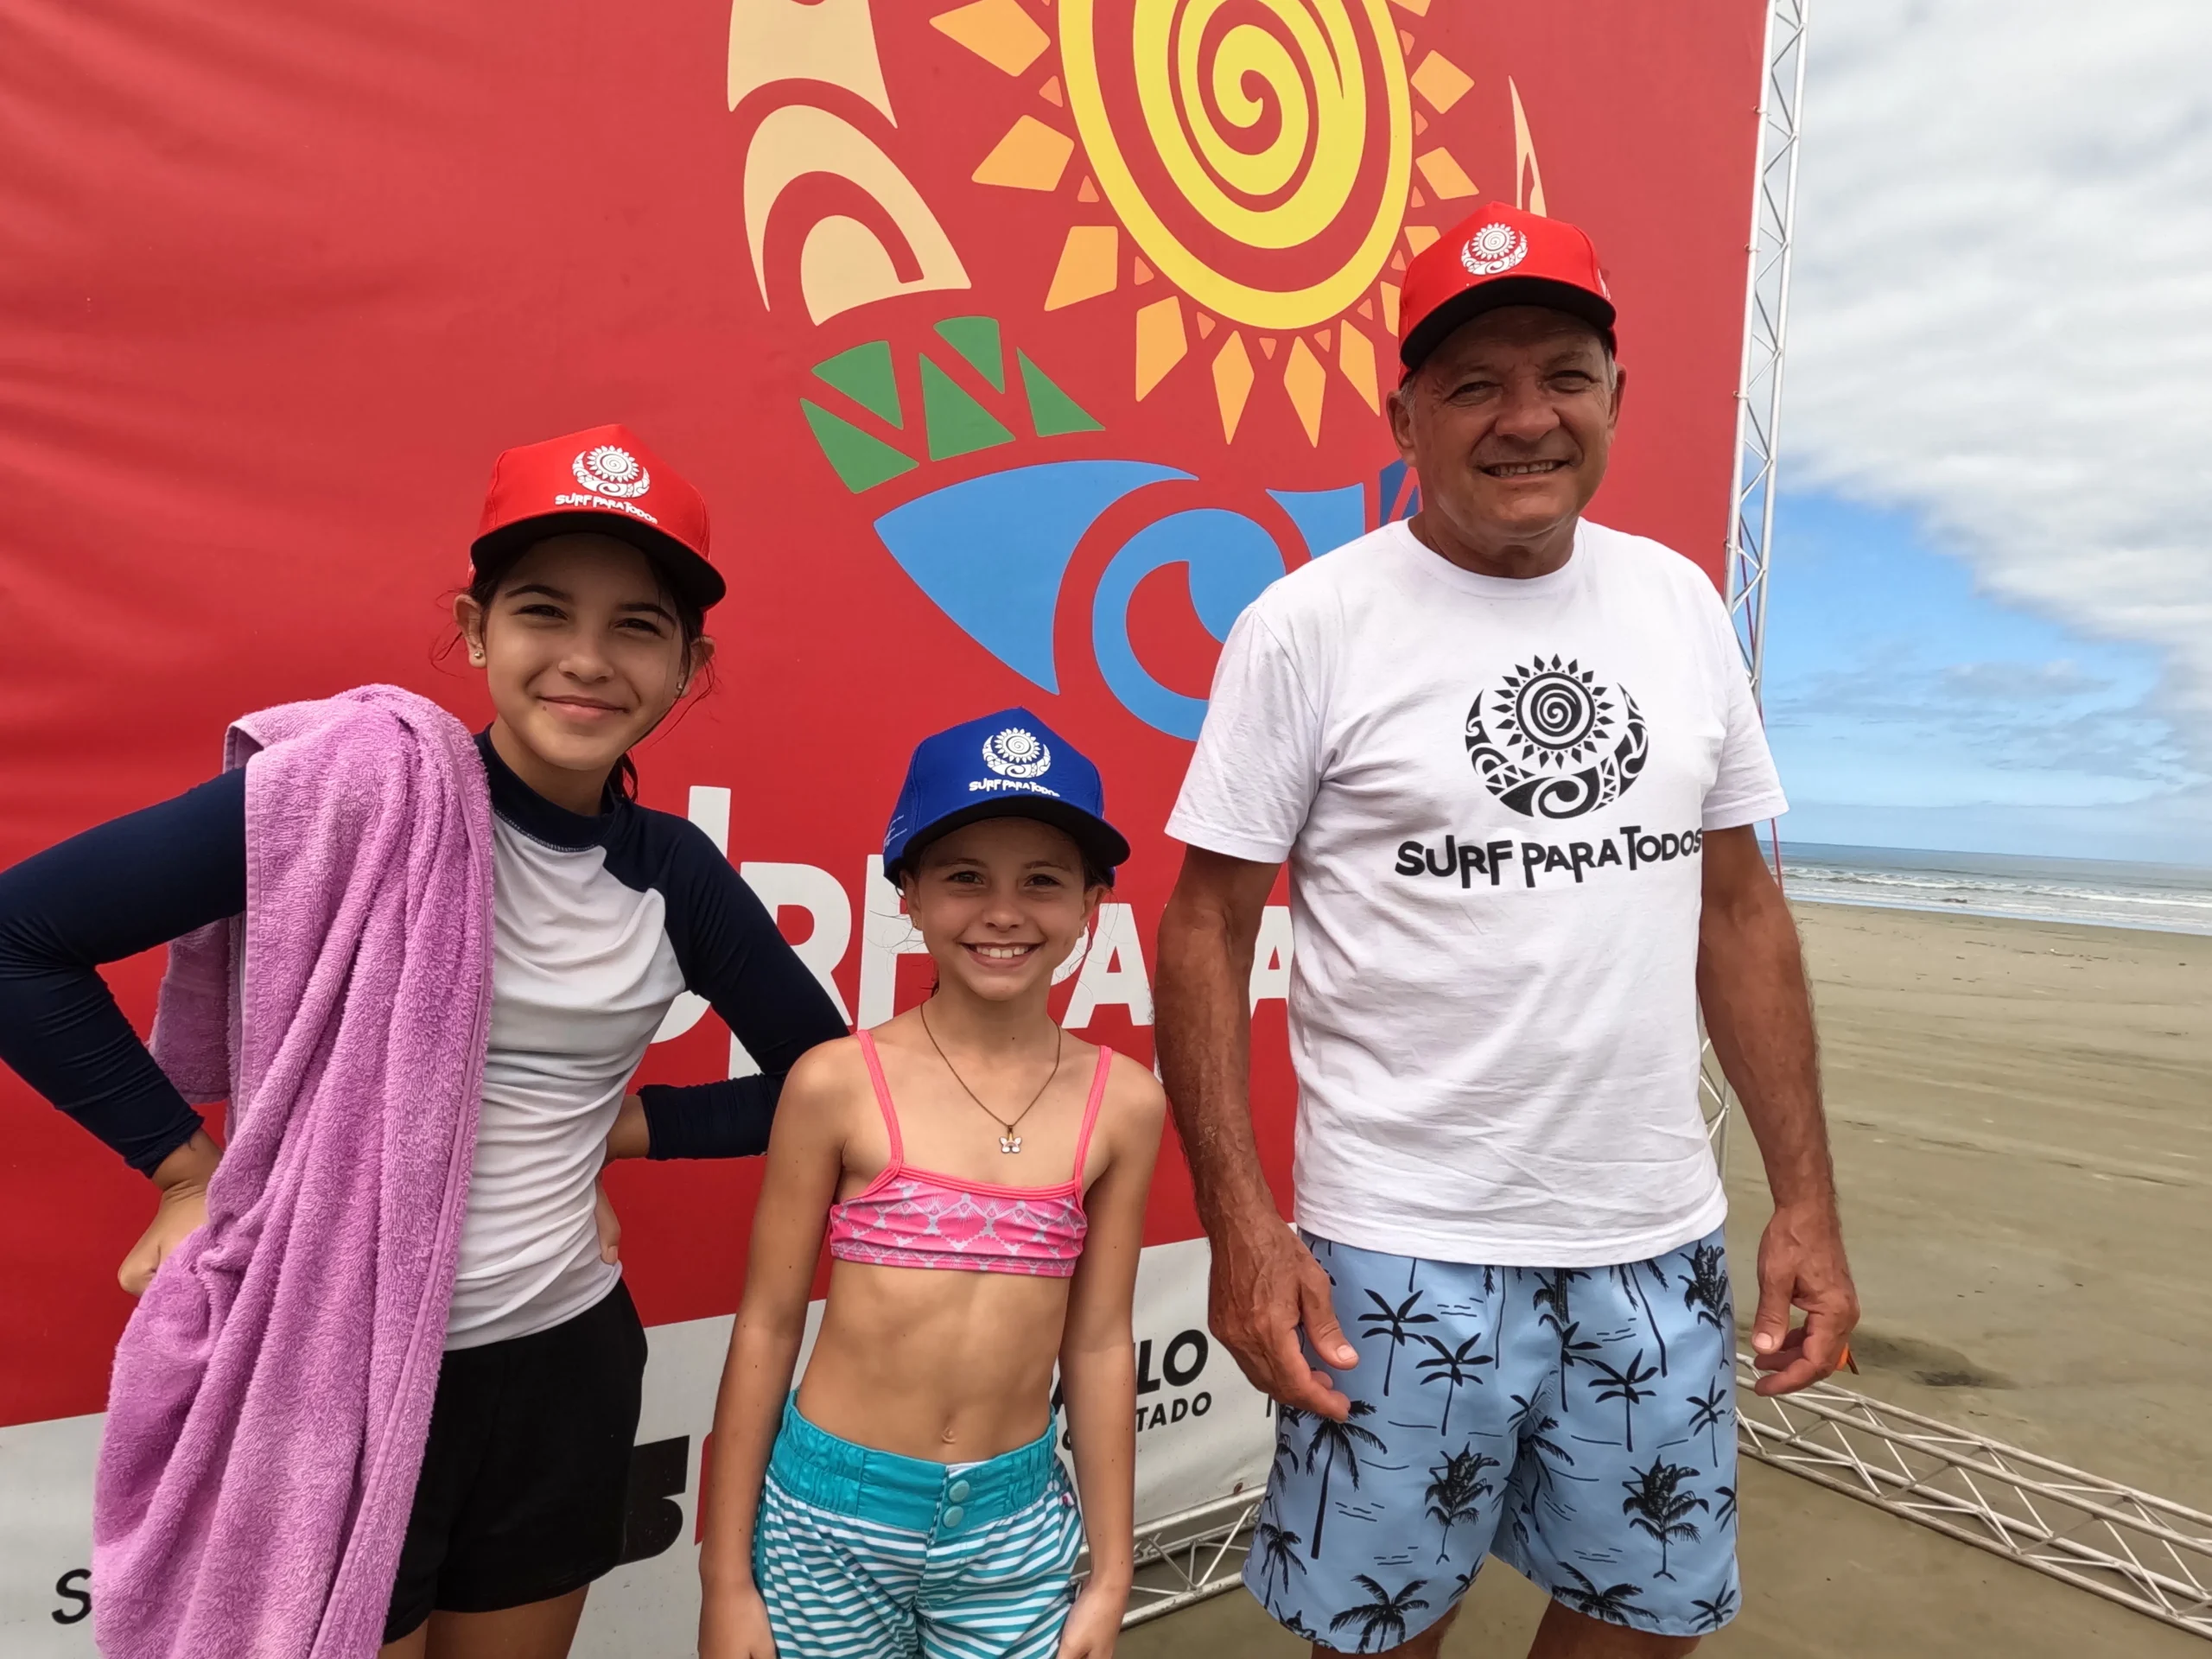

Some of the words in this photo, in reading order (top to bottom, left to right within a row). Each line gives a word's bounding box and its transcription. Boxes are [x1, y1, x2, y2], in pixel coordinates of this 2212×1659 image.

[555, 493, 593, 506] SURF
[593, 496, 624, 510] PARA
[969, 778, 1001, 791] SURF
[1002, 779, 1030, 791] PARA
[1395, 835, 1513, 888] SURF
[1522, 838, 1623, 888] PARA
[1620, 825, 1702, 870] TODOS
[1134, 1329, 1209, 1395] LO
